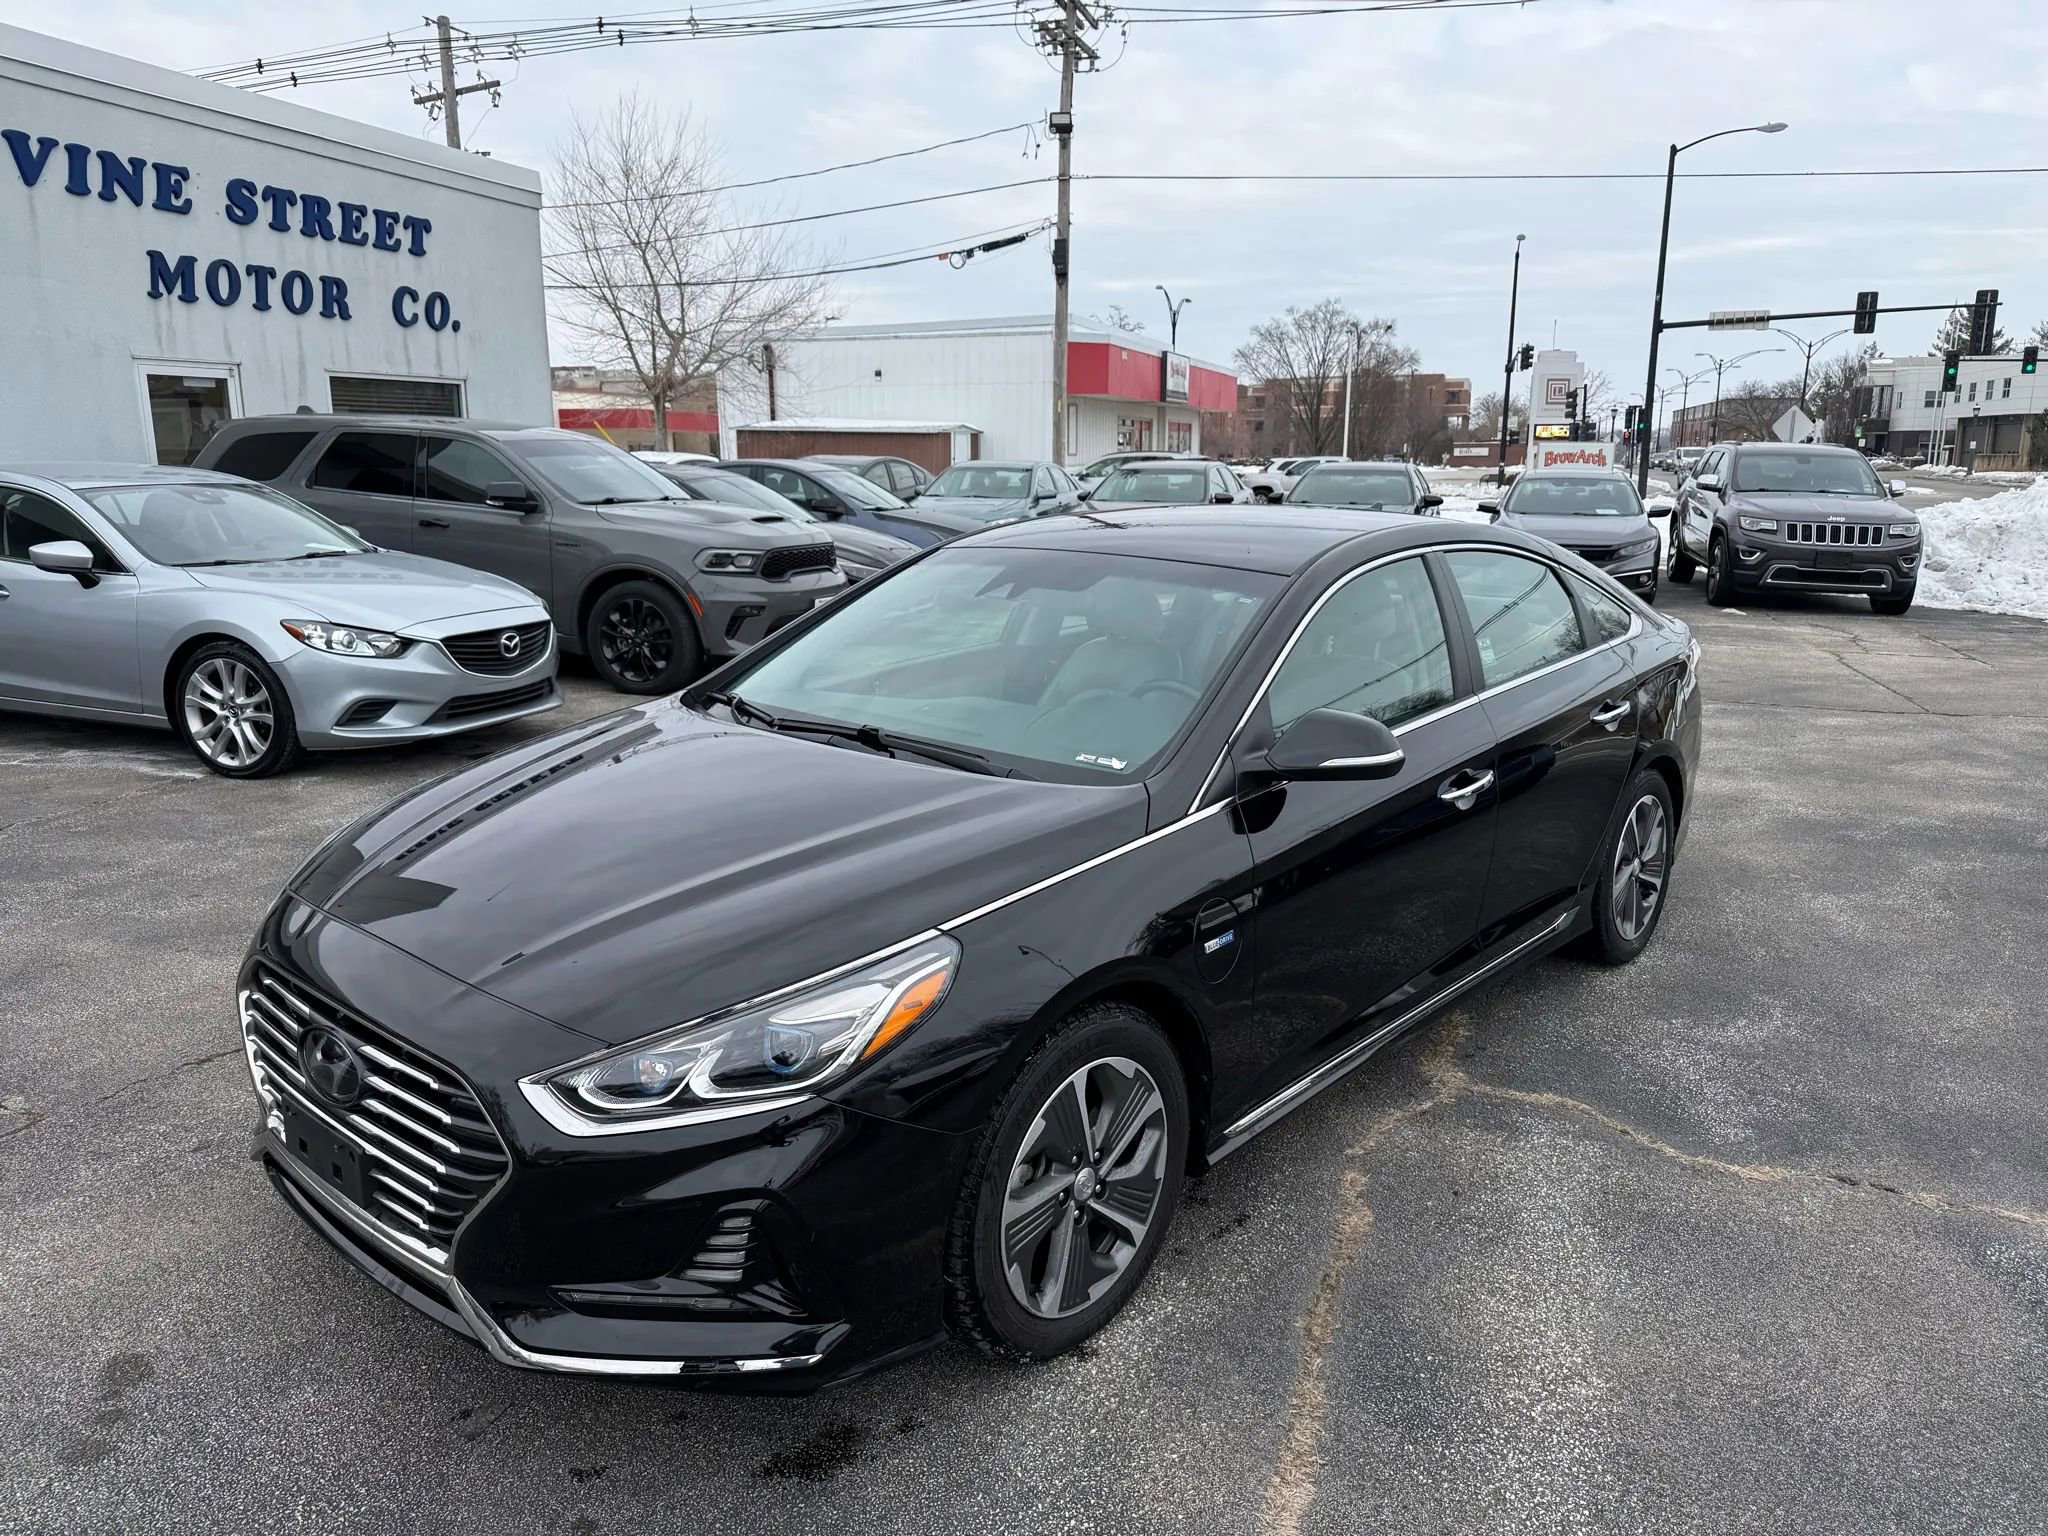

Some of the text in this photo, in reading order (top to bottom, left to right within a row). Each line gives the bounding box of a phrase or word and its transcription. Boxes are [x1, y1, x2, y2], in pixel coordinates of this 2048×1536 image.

[1, 129, 432, 257] VINE STREET
[146, 249, 461, 333] MOTOR CO.
[1544, 448, 1607, 467] BrowArch
